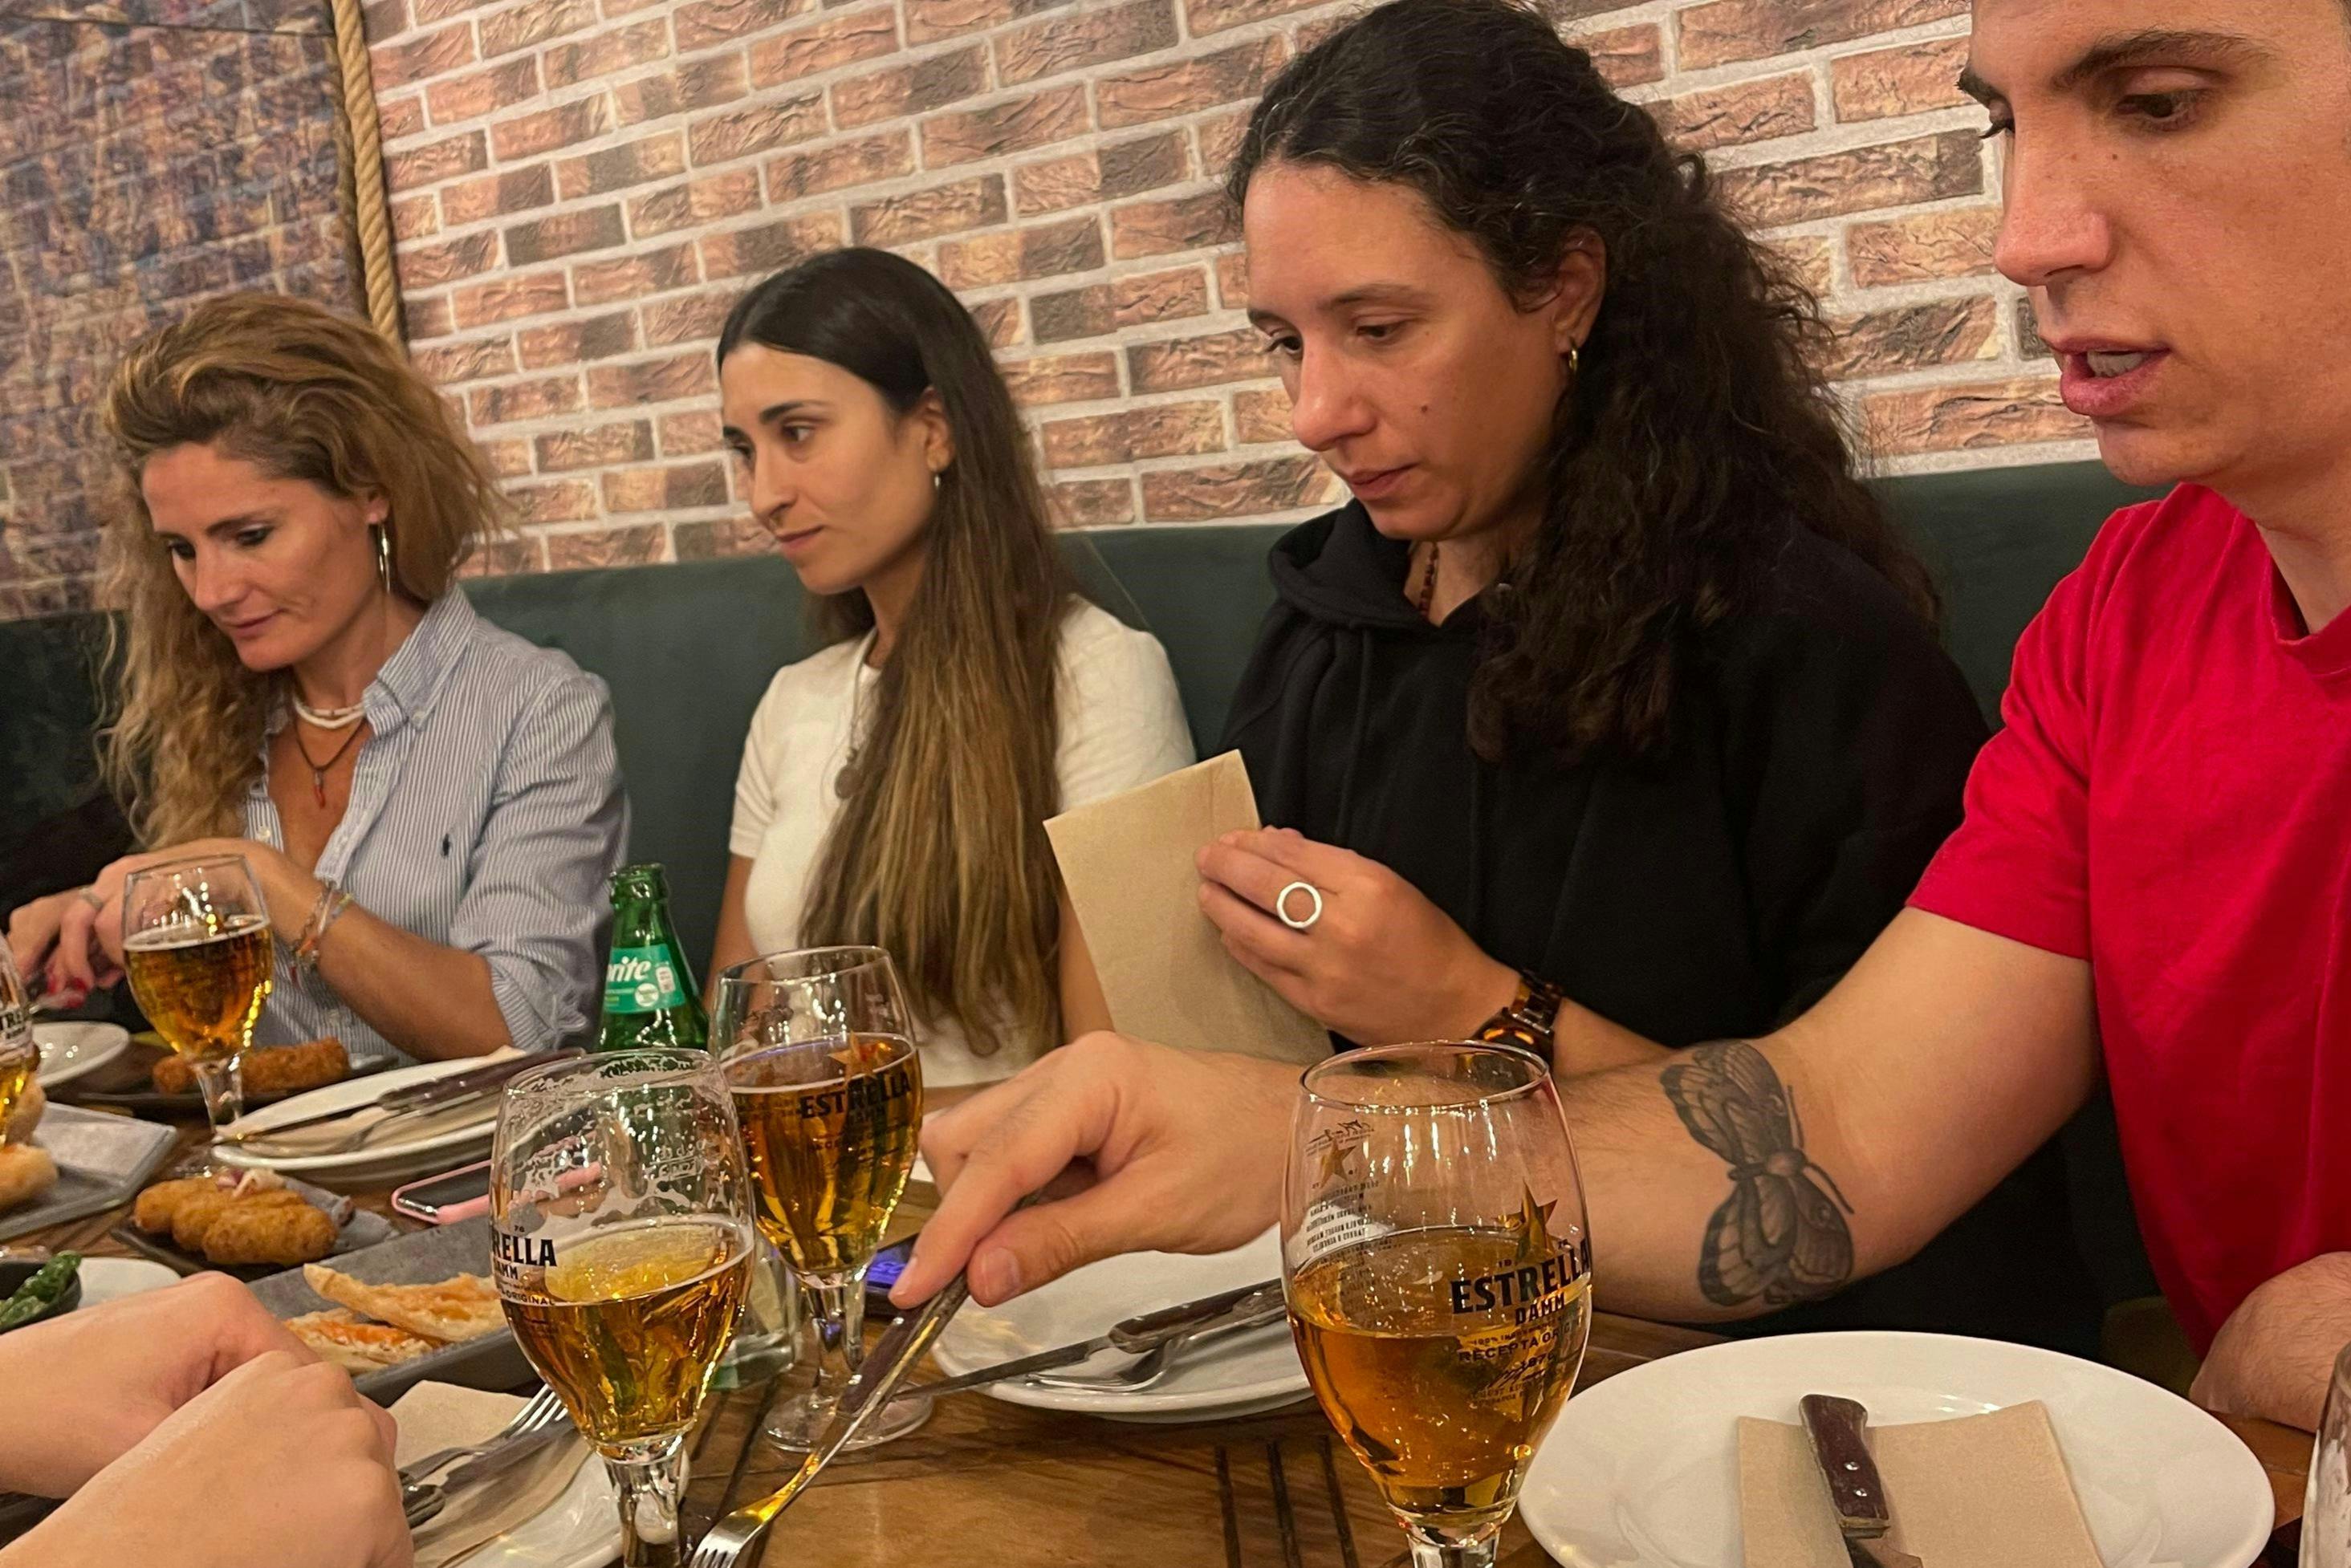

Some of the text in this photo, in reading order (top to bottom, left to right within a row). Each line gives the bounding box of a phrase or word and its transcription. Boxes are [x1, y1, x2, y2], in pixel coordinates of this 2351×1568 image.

[608, 956, 651, 982] rite
[800, 1070, 911, 1119] ESTRELLA
[492, 1230, 557, 1267] RELLA
[1450, 1237, 1589, 1314] ESTRELLA
[1515, 1291, 1565, 1326] DAMM
[1458, 1336, 1539, 1362] RECEPTA
